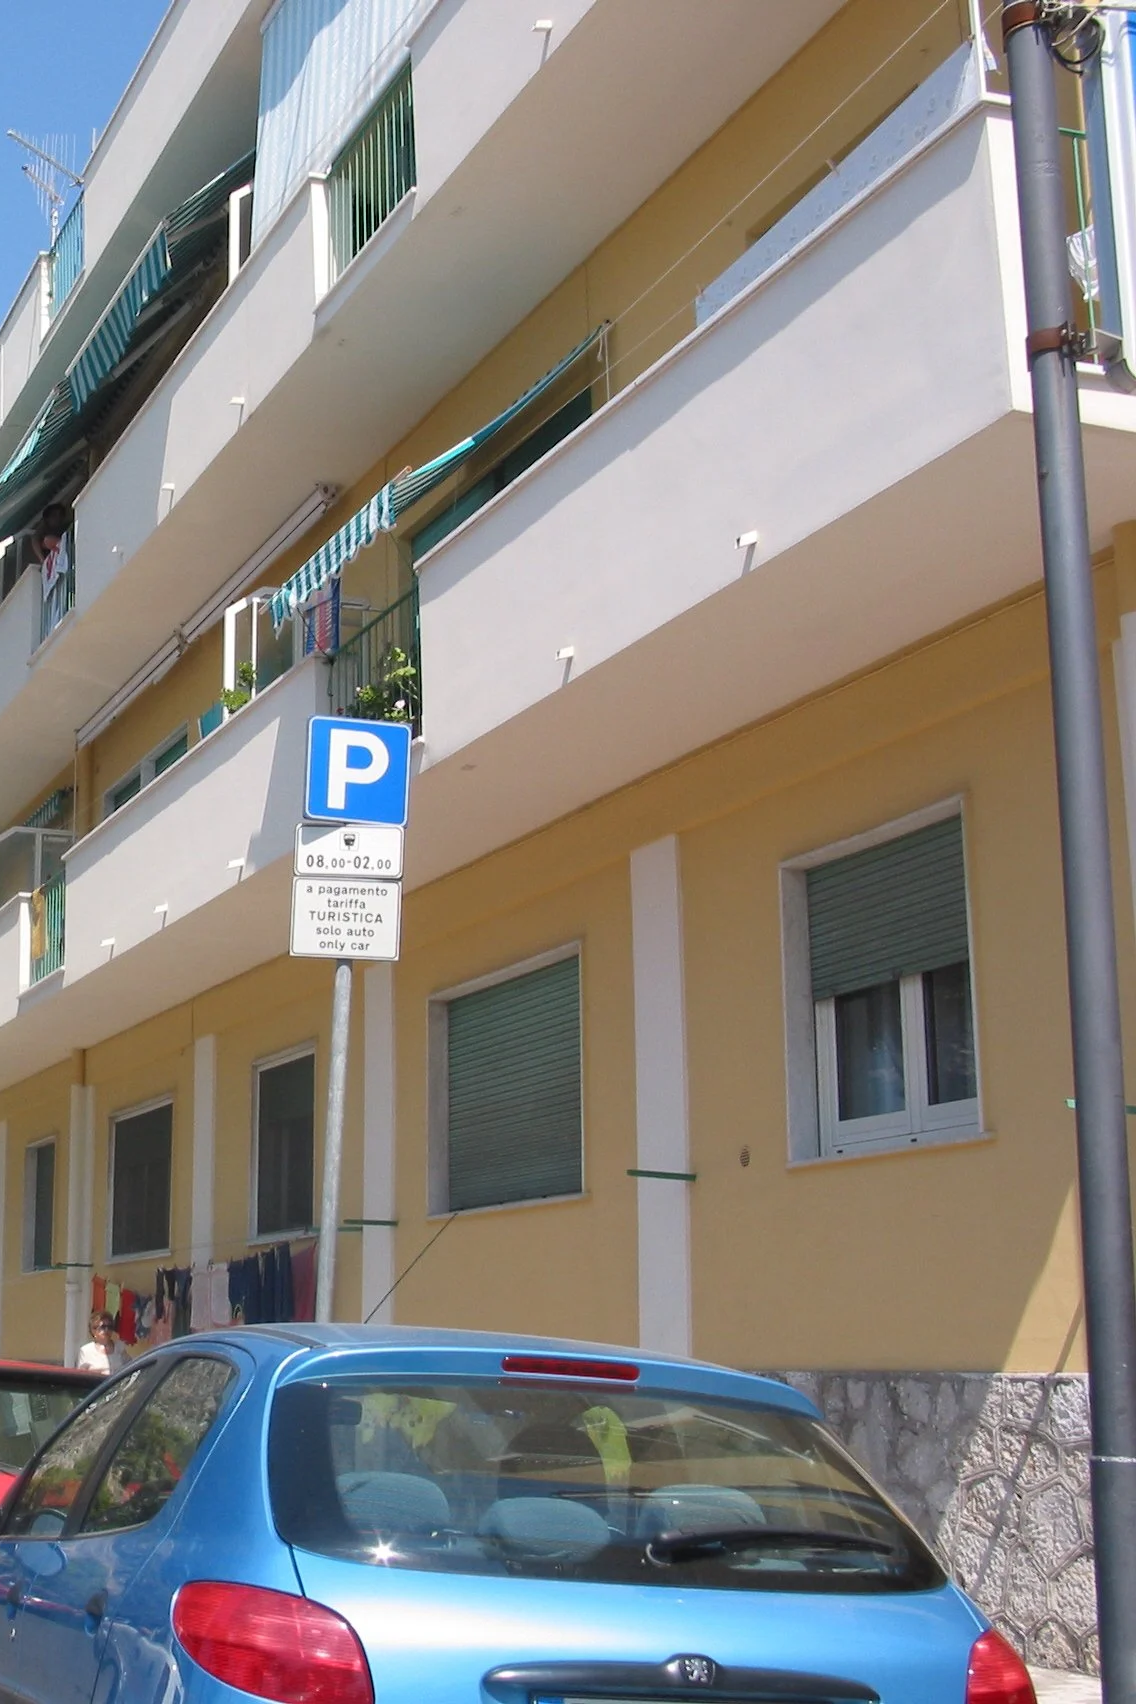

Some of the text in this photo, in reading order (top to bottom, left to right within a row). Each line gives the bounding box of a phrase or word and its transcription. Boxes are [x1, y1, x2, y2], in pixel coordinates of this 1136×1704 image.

[327, 728, 390, 810] P
[306, 854, 392, 871] 08.00-02.00
[306, 885, 389, 897] a pagamento
[327, 898, 366, 909] tariffa
[309, 911, 383, 924] TURISTICA
[316, 925, 375, 938] solo auto
[319, 939, 370, 951] only car
